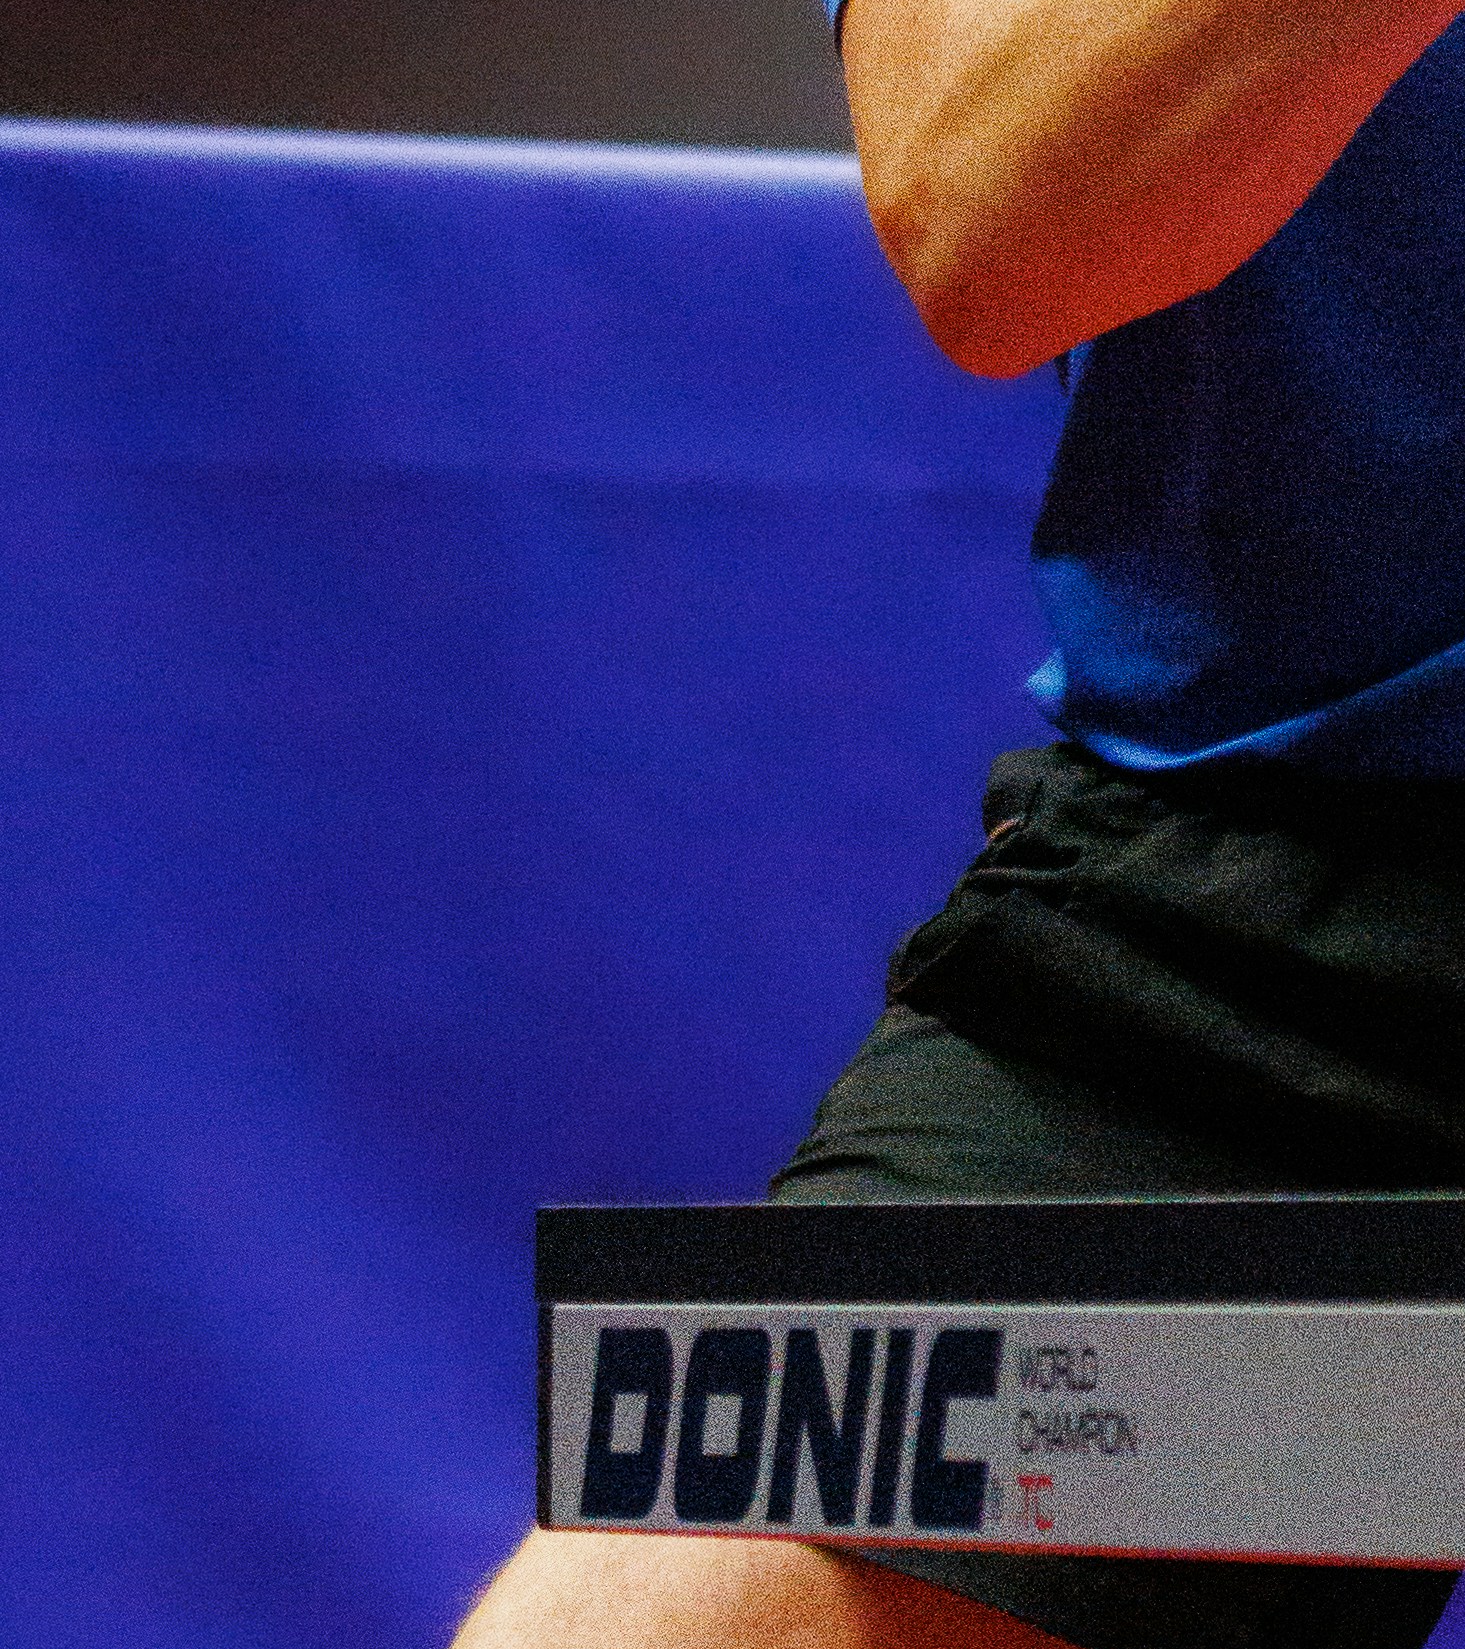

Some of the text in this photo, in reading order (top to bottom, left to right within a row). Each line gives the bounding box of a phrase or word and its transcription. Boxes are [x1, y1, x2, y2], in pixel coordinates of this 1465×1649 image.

[1017, 1345, 1100, 1393] WORLD
[579, 1326, 1001, 1532] DONIC
[1015, 1472, 1055, 1532] TC
